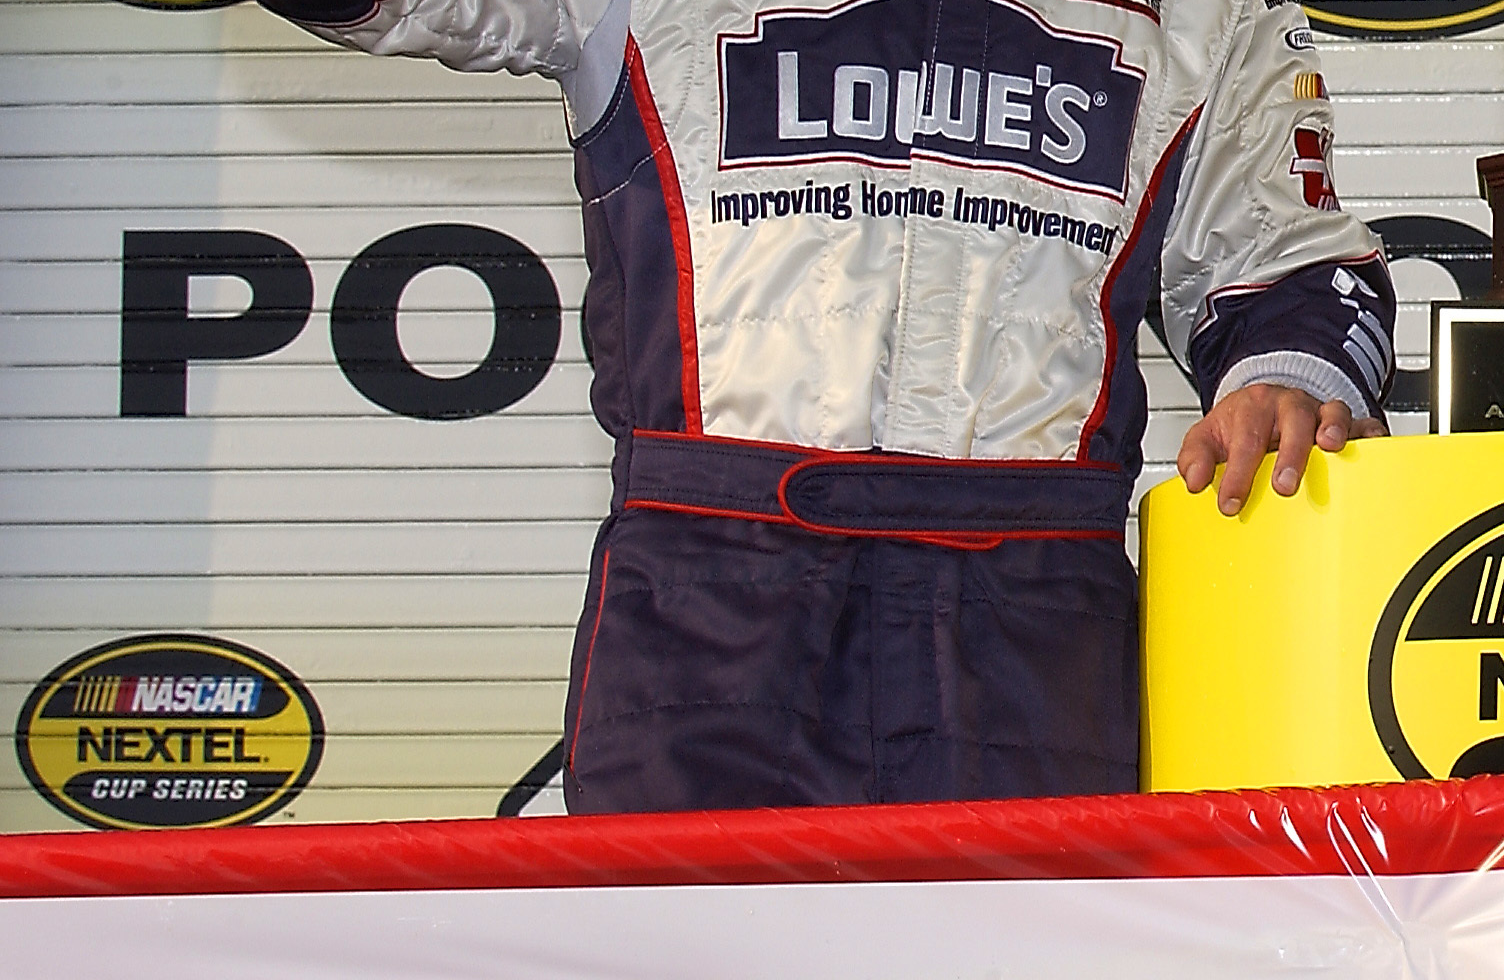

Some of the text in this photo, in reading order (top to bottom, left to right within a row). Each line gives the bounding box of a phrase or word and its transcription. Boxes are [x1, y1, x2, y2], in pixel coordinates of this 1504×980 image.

[776, 50, 1091, 165] LOWE'S
[711, 180, 1119, 257] Improving Home Improvemen
[132, 677, 255, 712] NASCAR
[76, 727, 261, 763] NEXTEL
[91, 779, 248, 800] CUP SERIES
